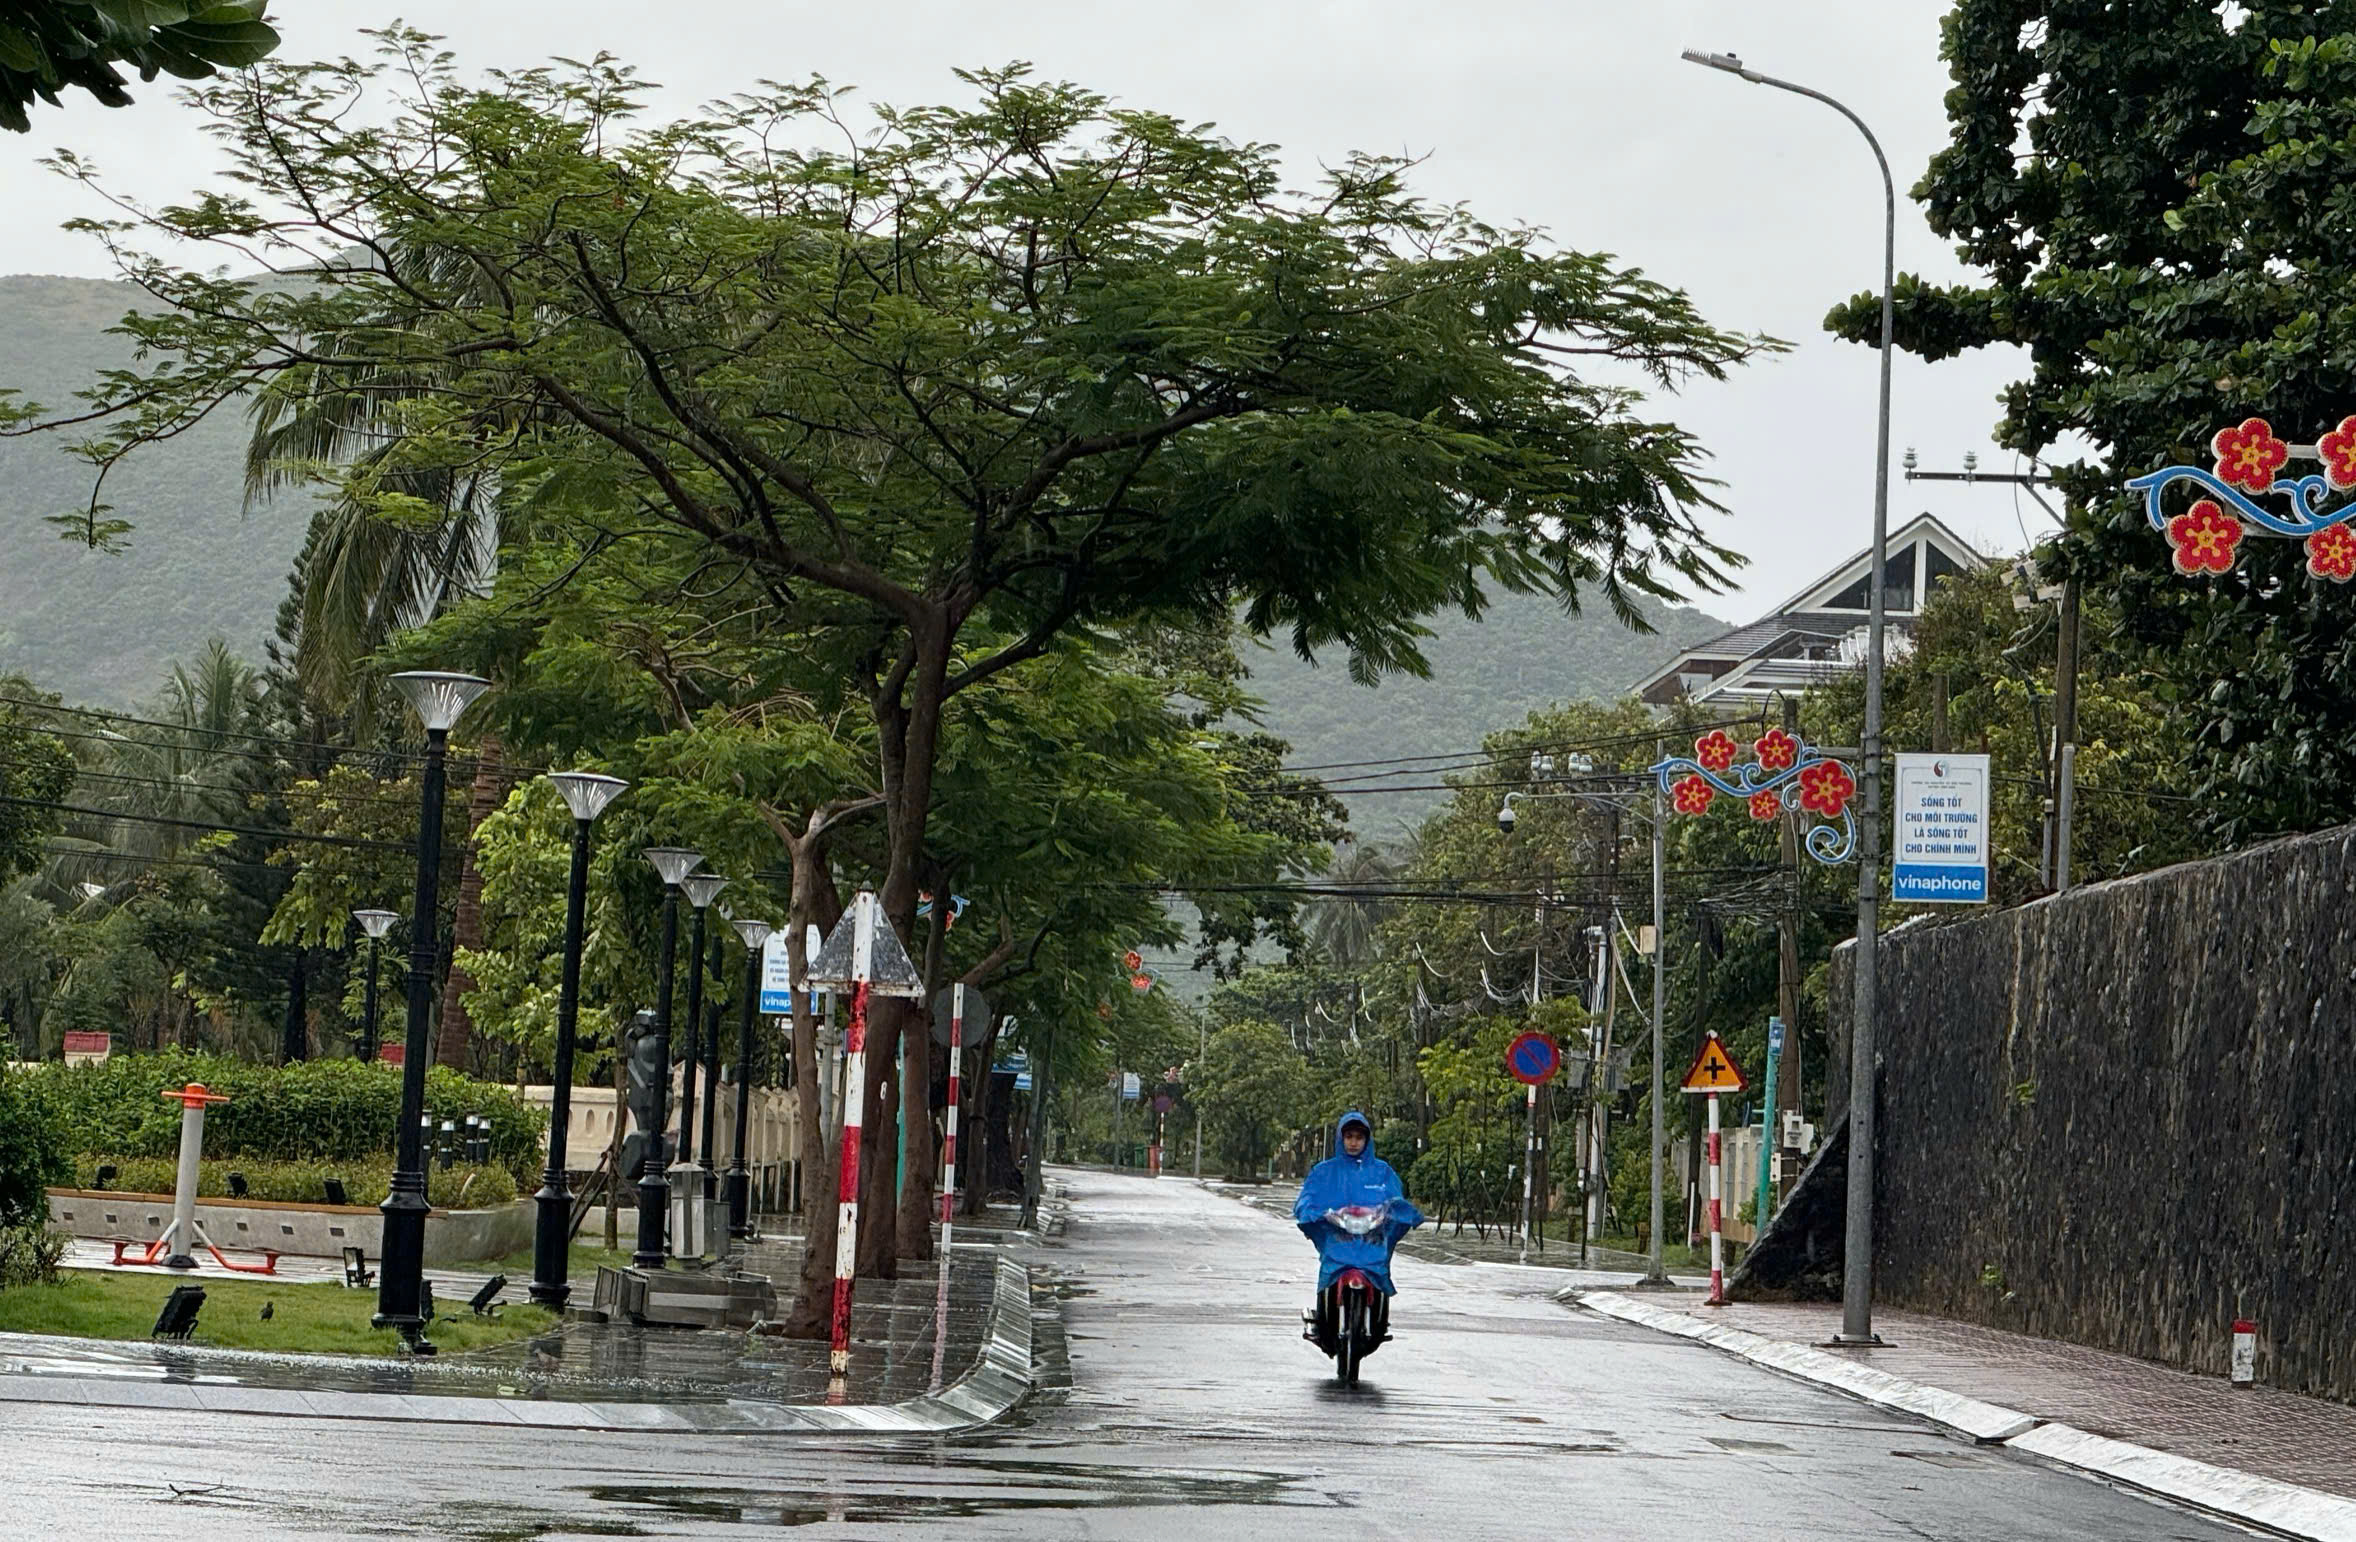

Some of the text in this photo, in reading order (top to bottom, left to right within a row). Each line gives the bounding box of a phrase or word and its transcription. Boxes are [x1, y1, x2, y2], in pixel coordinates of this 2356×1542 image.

[1905, 812, 1922, 822] CHO
[1914, 826, 1924, 838] LÀ
[1905, 843, 1922, 853] CHO
[1898, 873, 1982, 892] vinaphone
